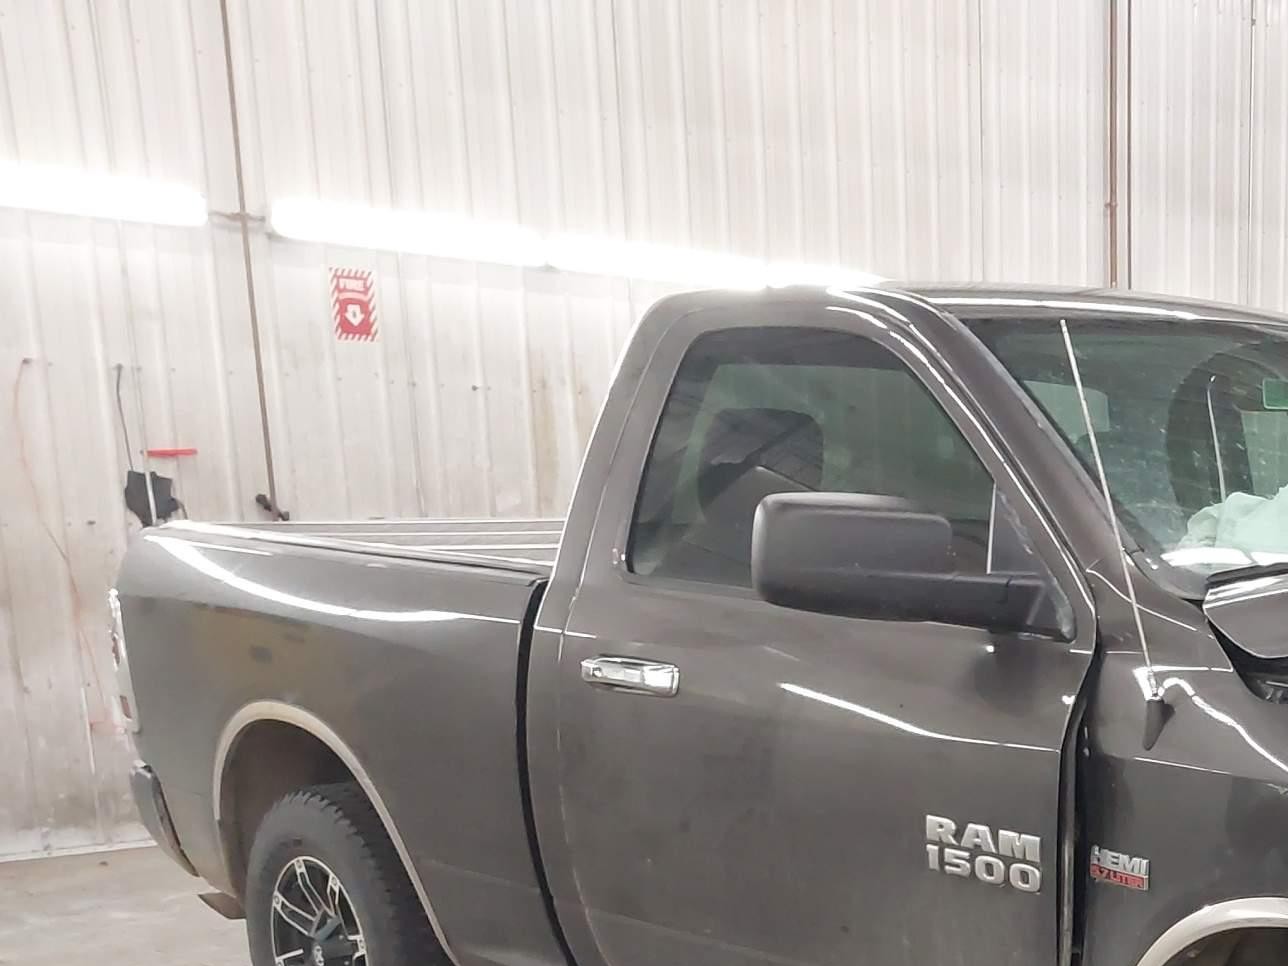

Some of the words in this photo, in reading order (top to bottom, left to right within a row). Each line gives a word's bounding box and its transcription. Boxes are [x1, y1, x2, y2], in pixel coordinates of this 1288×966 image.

[926, 814, 1041, 862] RAM
[1091, 845, 1149, 877] HEMI
[926, 844, 1041, 893] 1500
